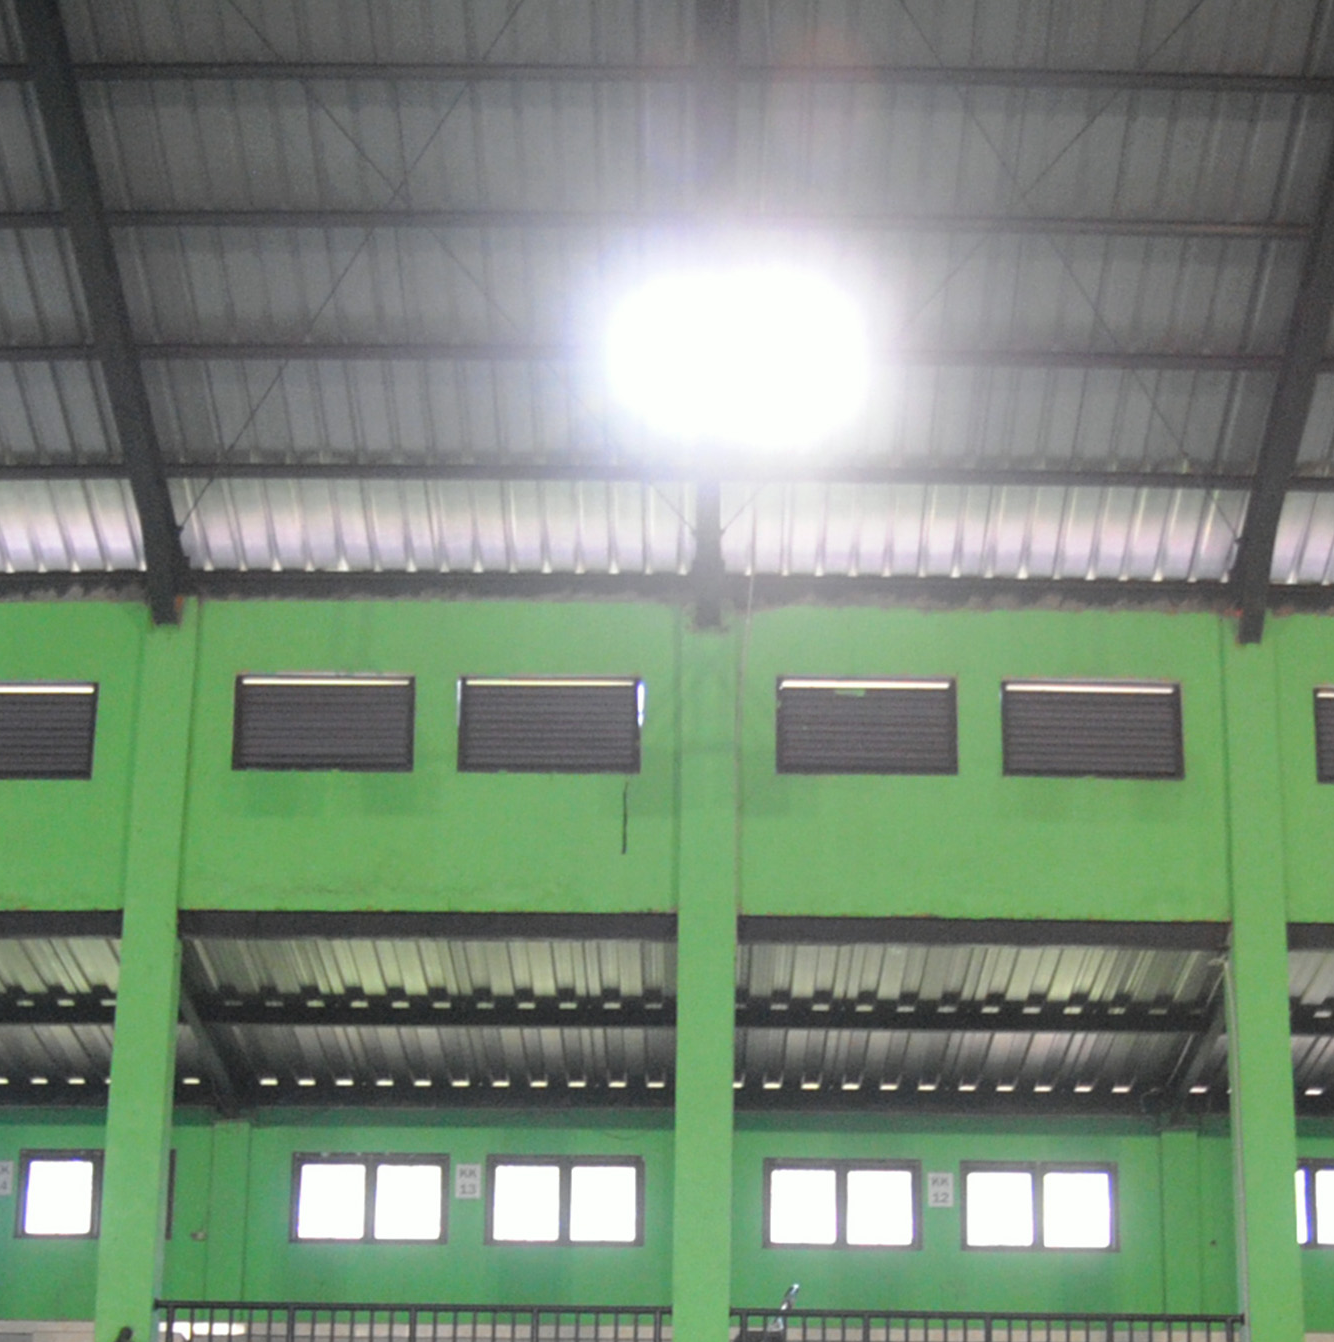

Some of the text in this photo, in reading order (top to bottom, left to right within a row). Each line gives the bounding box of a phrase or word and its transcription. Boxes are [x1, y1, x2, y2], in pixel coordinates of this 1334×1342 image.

[459, 1169, 477, 1179] KK
[931, 1176, 949, 1186] KK
[460, 1184, 476, 1195] 13
[931, 1191, 949, 1202] 12
